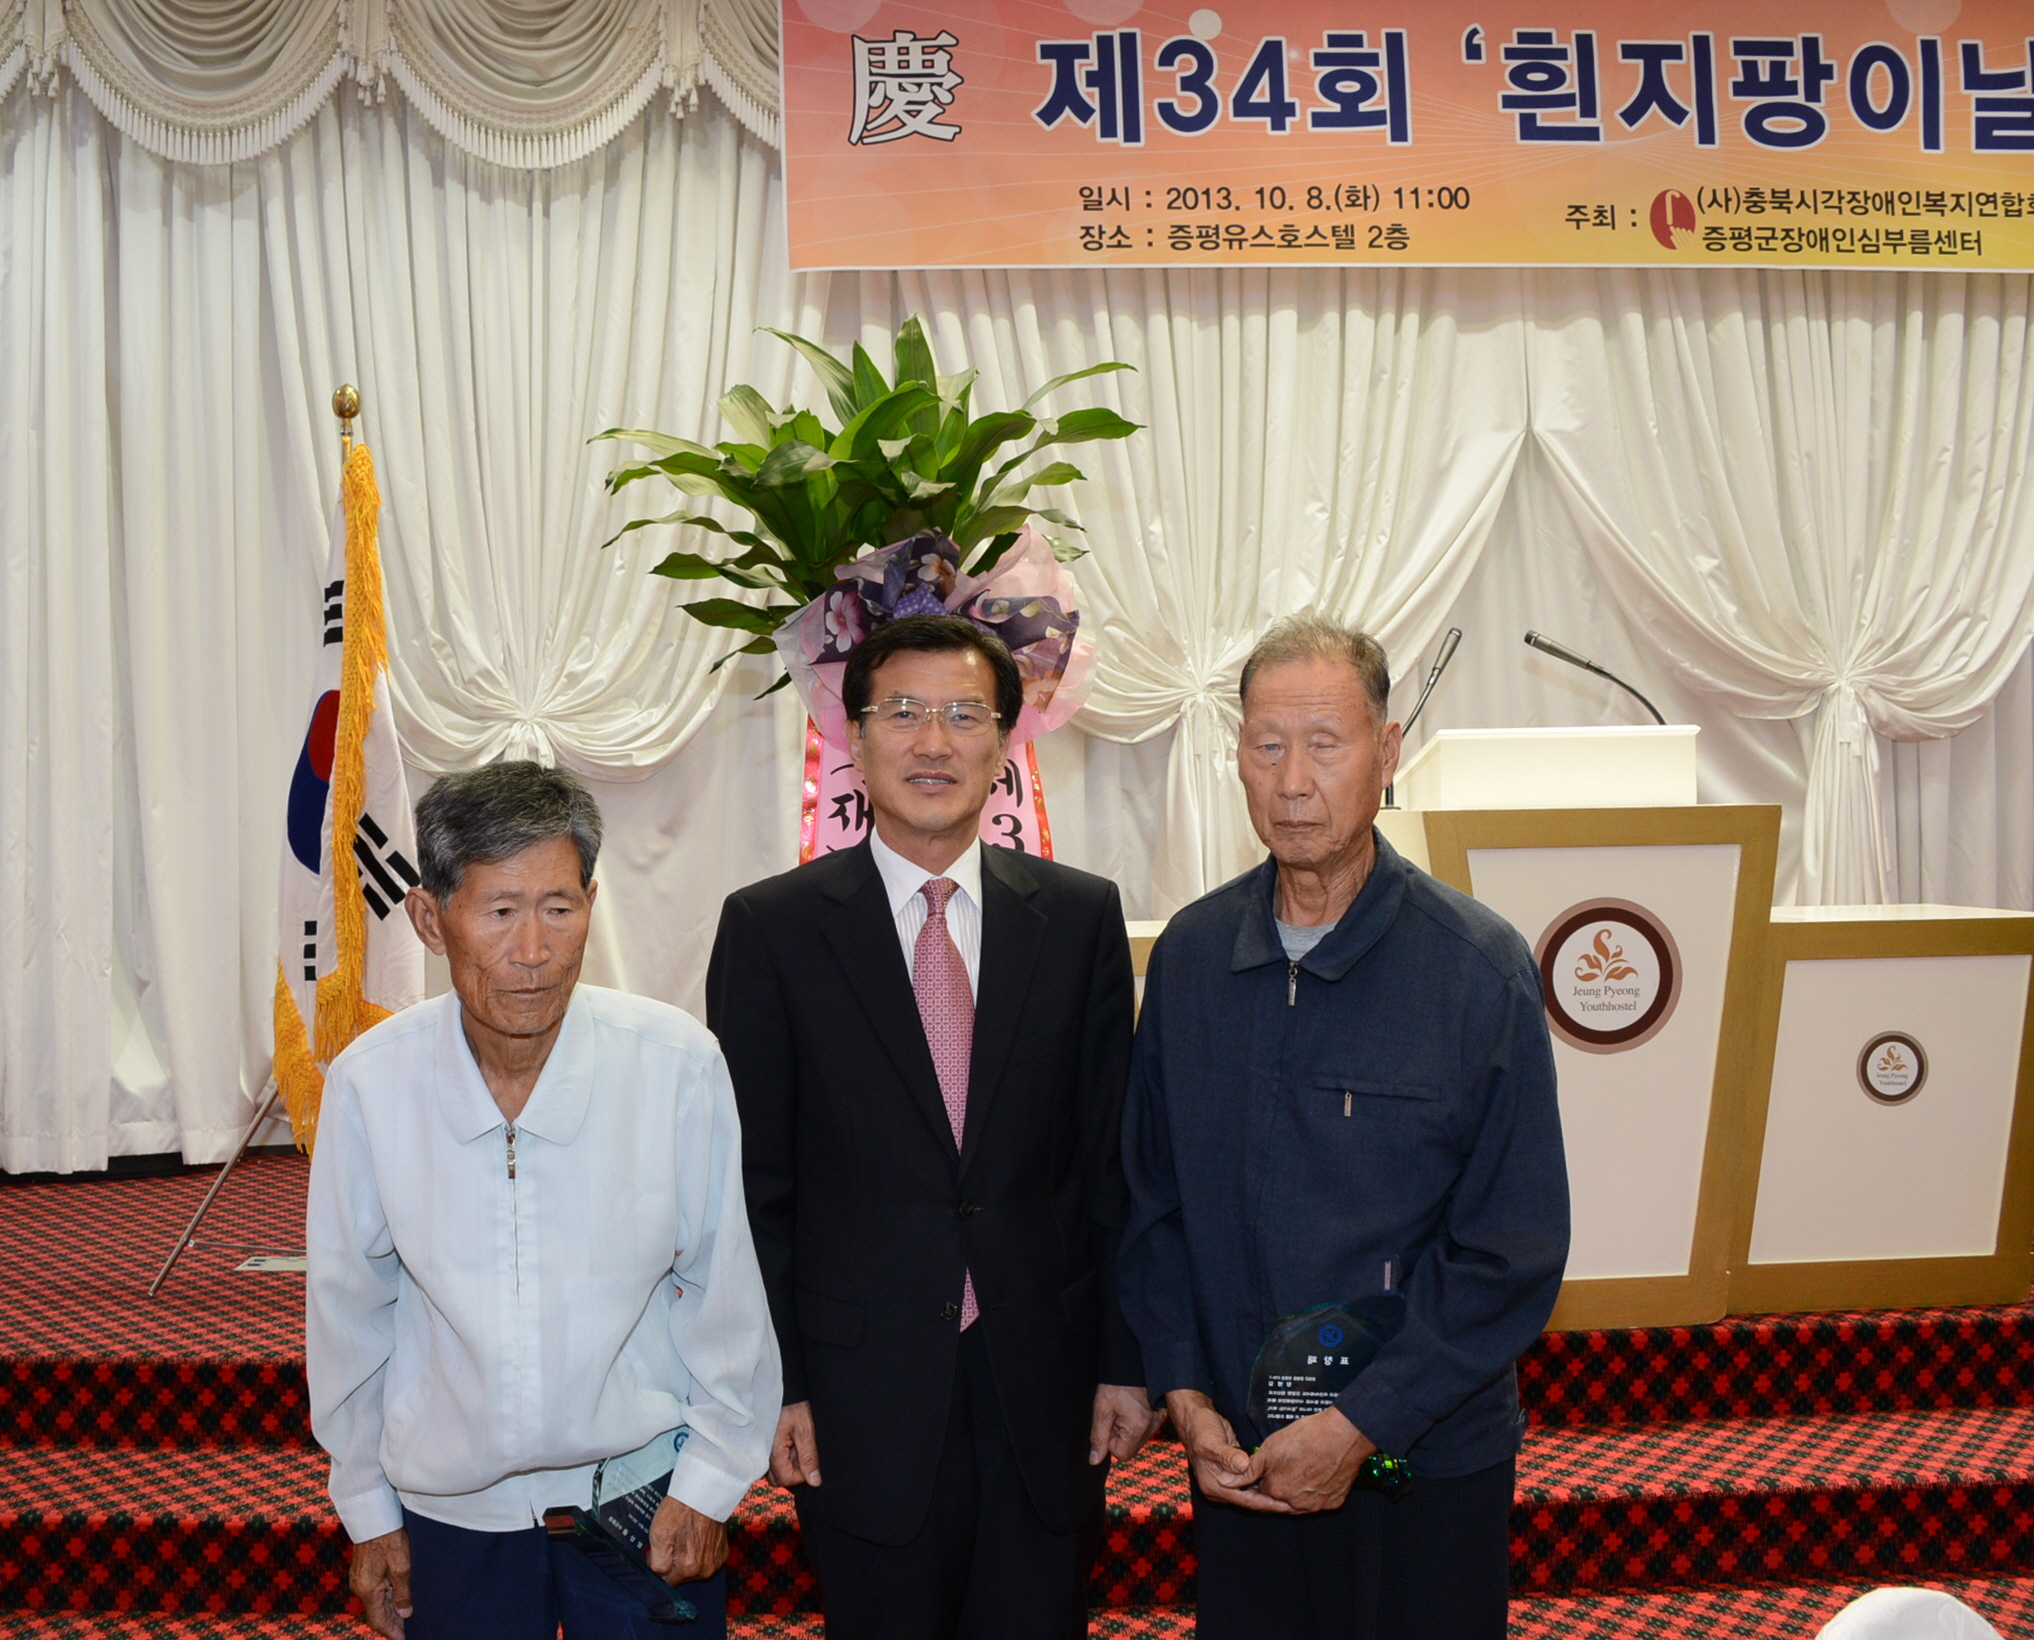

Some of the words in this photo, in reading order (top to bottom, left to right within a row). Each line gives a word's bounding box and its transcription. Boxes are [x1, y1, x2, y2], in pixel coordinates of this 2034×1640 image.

[848, 30, 965, 147] 慶
[1032, 28, 1411, 146] 제34회
[1078, 186, 1131, 212] 일시
[1165, 186, 1242, 212] 2013.
[1254, 186, 1295, 211] 10.
[1306, 183, 1380, 213] 8.(화)
[1393, 186, 1471, 210] 11:00
[1564, 204, 1617, 231] 주최
[1078, 224, 1133, 252] 장소
[1166, 223, 1357, 251] 증평유스호스텔
[1367, 223, 1411, 251] 2층
[1701, 225, 1983, 256] 증평군장애인심부름센터
[1572, 986, 1601, 998] Jeung
[1603, 985, 1641, 998] Pyeong
[1579, 1001, 1637, 1012] Youthhostel
